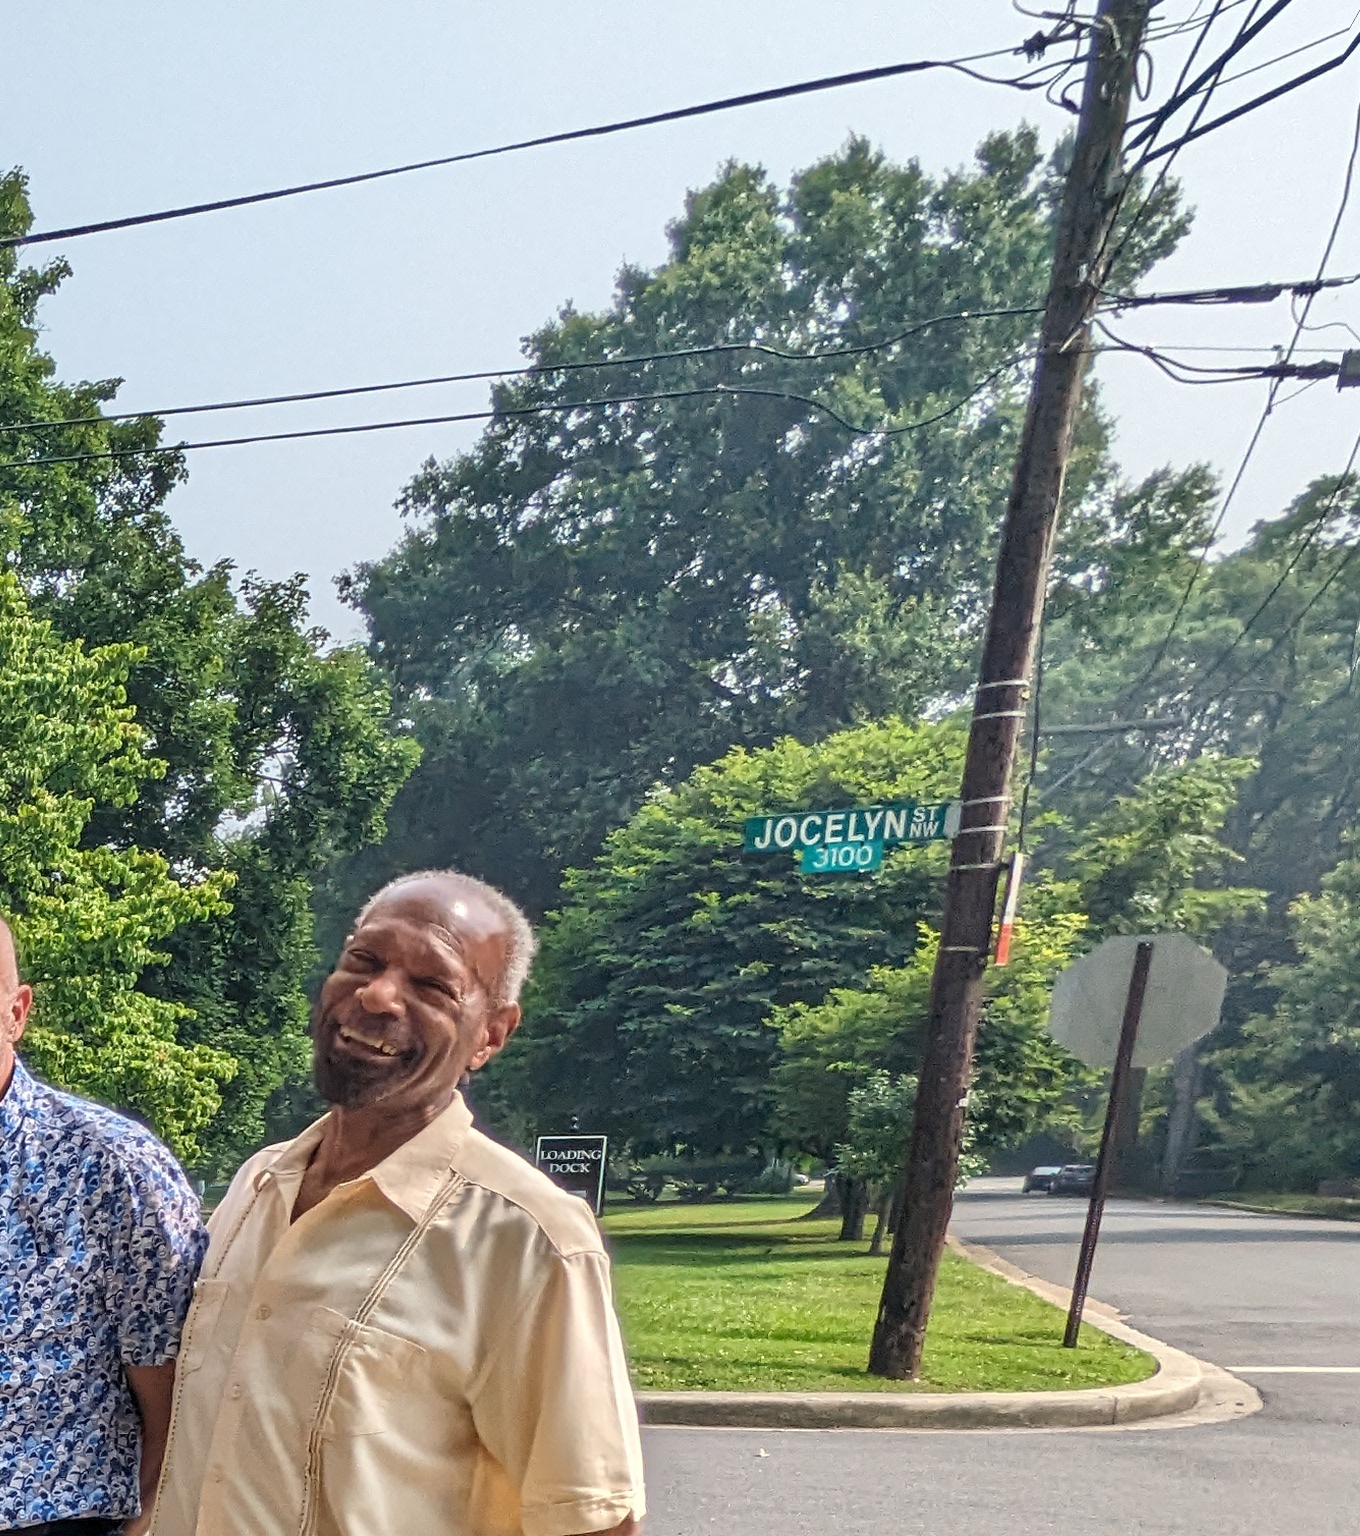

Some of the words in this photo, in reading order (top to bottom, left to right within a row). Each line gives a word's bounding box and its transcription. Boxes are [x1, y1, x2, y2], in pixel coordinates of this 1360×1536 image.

[913, 806, 940, 823] ST
[754, 809, 908, 849] JOCELYN
[909, 820, 940, 838] NW
[813, 845, 873, 868] 3100
[540, 1149, 602, 1160] LOADING
[549, 1162, 591, 1173] DOCK
